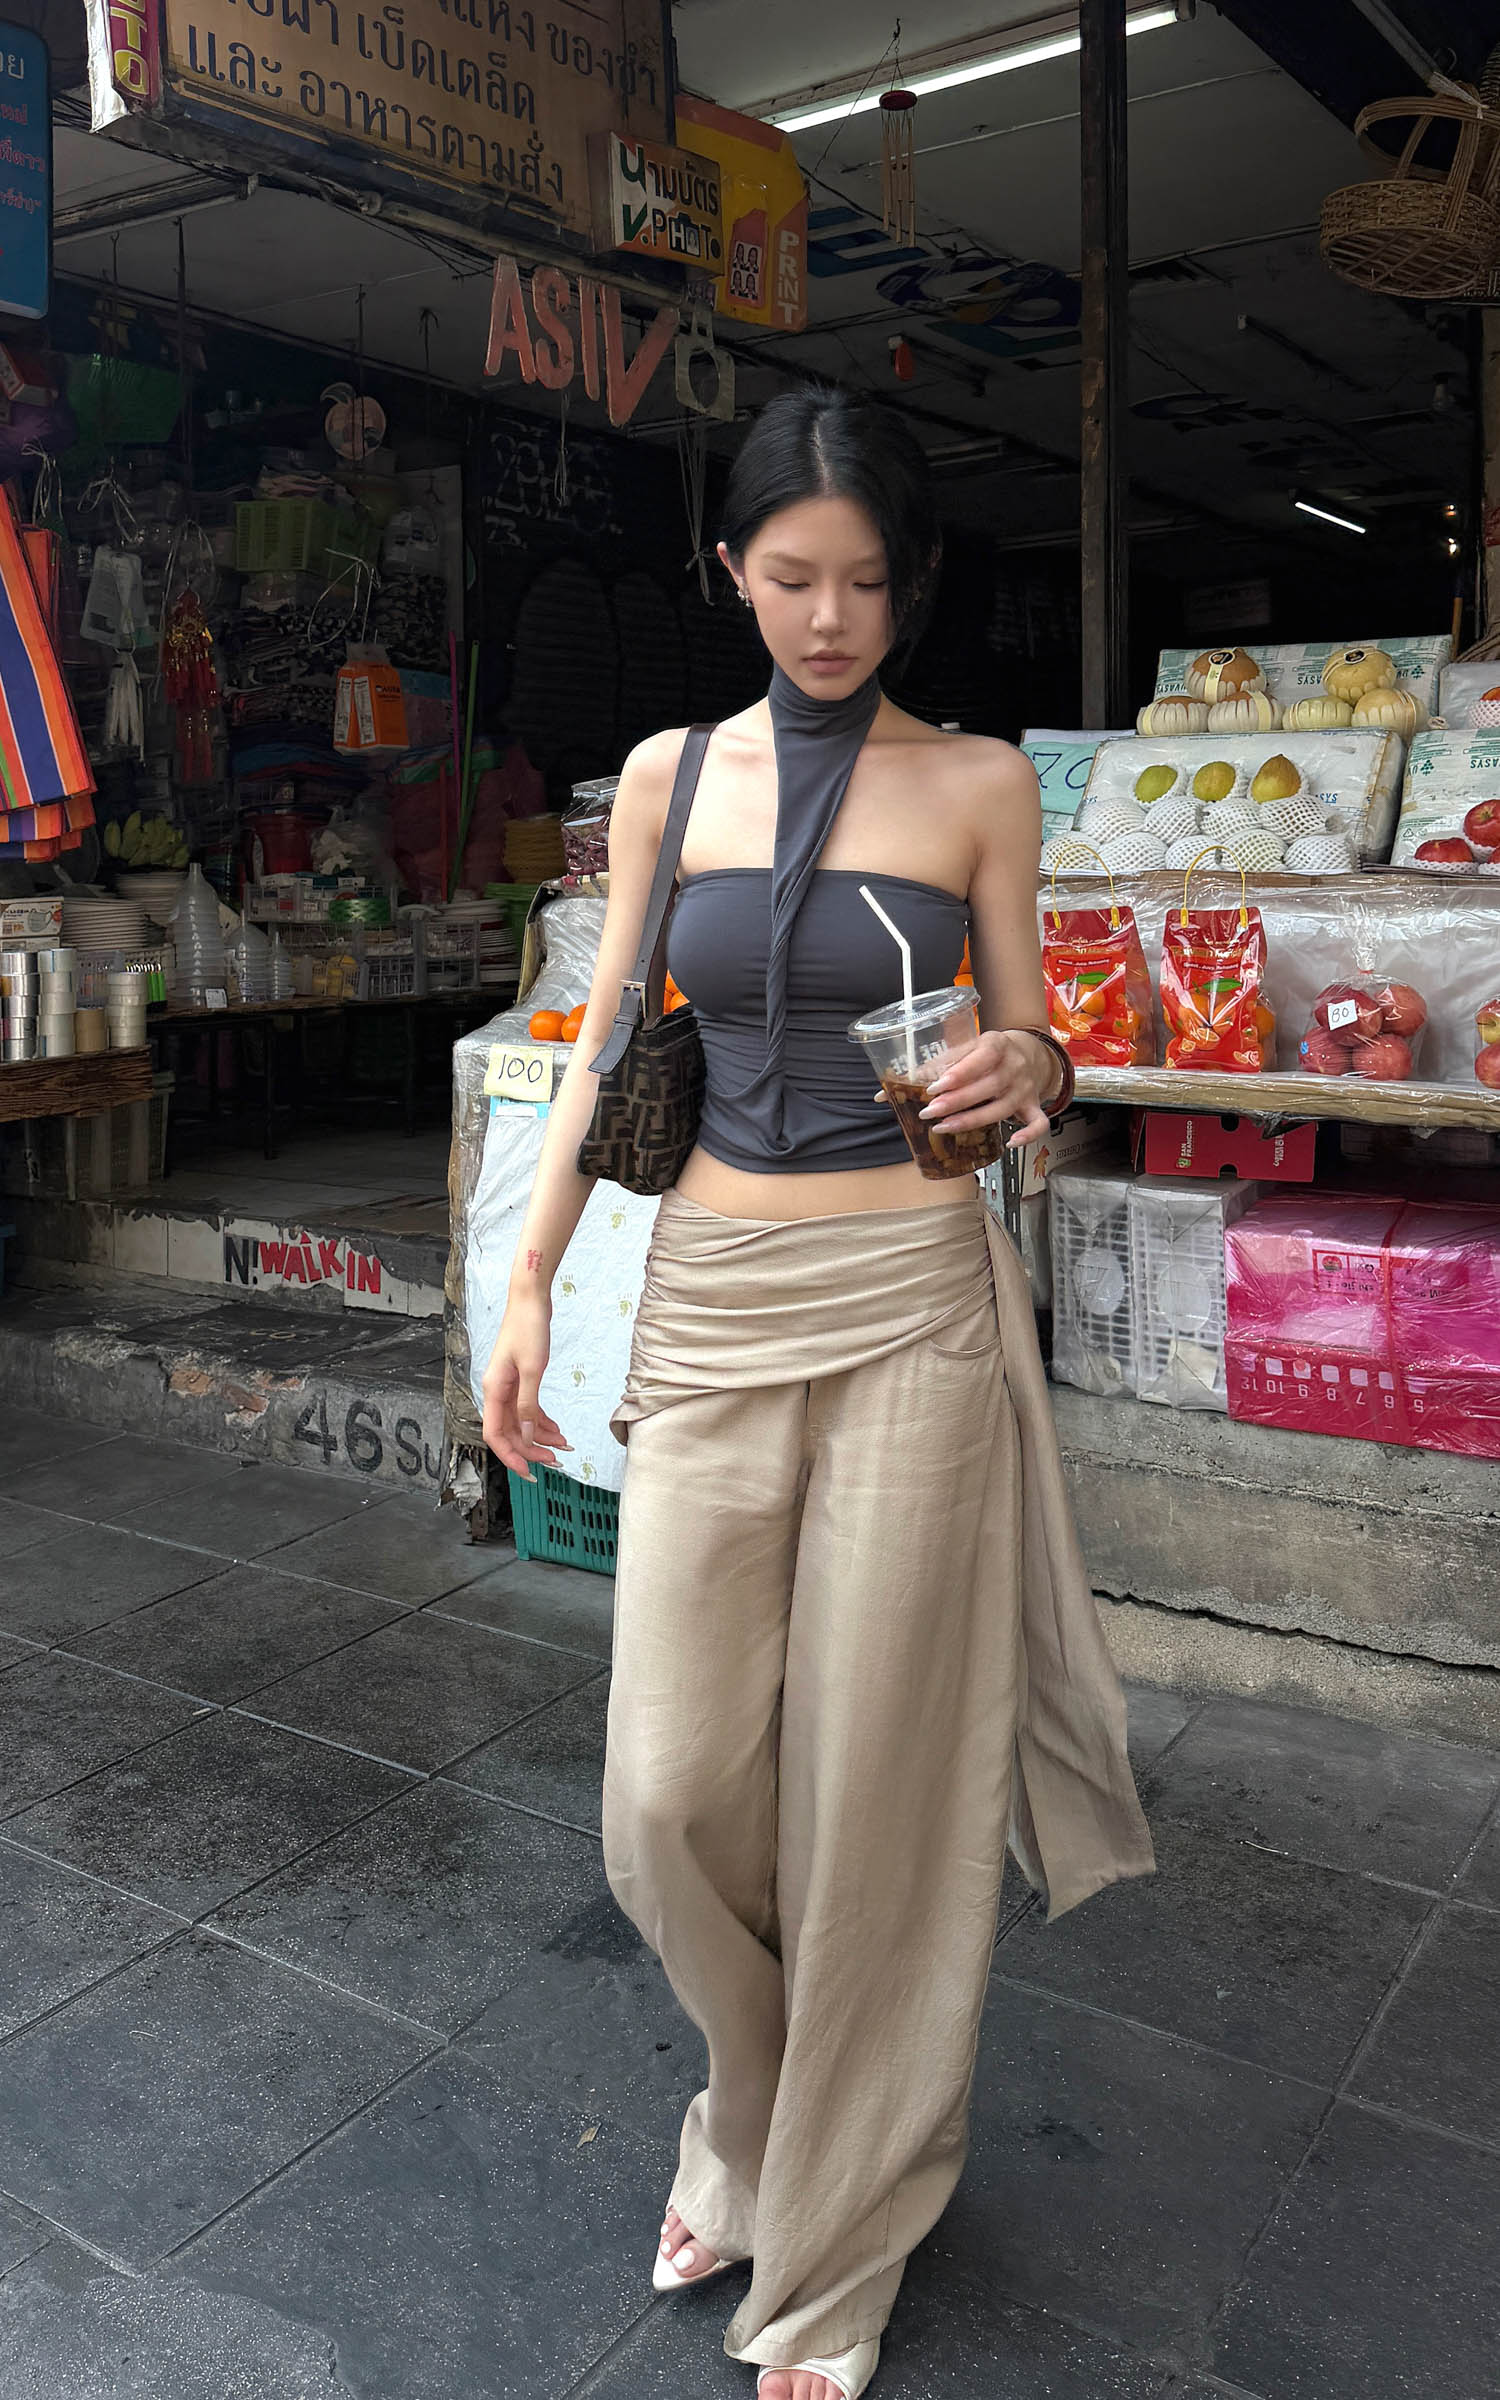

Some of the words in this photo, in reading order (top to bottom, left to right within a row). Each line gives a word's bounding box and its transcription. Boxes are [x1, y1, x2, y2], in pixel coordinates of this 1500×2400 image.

[188, 24, 283, 97] และ
[300, 69, 563, 203] อาหารตามสั่ง
[1297, 675, 1322, 686] ASYS
[1469, 758, 1500, 770] ASYS
[1331, 1006, 1350, 1024] 80
[498, 1053, 544, 1083] 100
[259, 1232, 345, 1284] WALK
[346, 1249, 382, 1295] IN
[1265, 1379, 1285, 1395] 10
[1298, 1383, 1308, 1397] 9
[1326, 1387, 1337, 1401] 8
[1354, 1391, 1366, 1405] 7
[1384, 1394, 1395, 1409] 6
[1413, 1398, 1425, 1413] 5
[291, 1388, 384, 1473] 46
